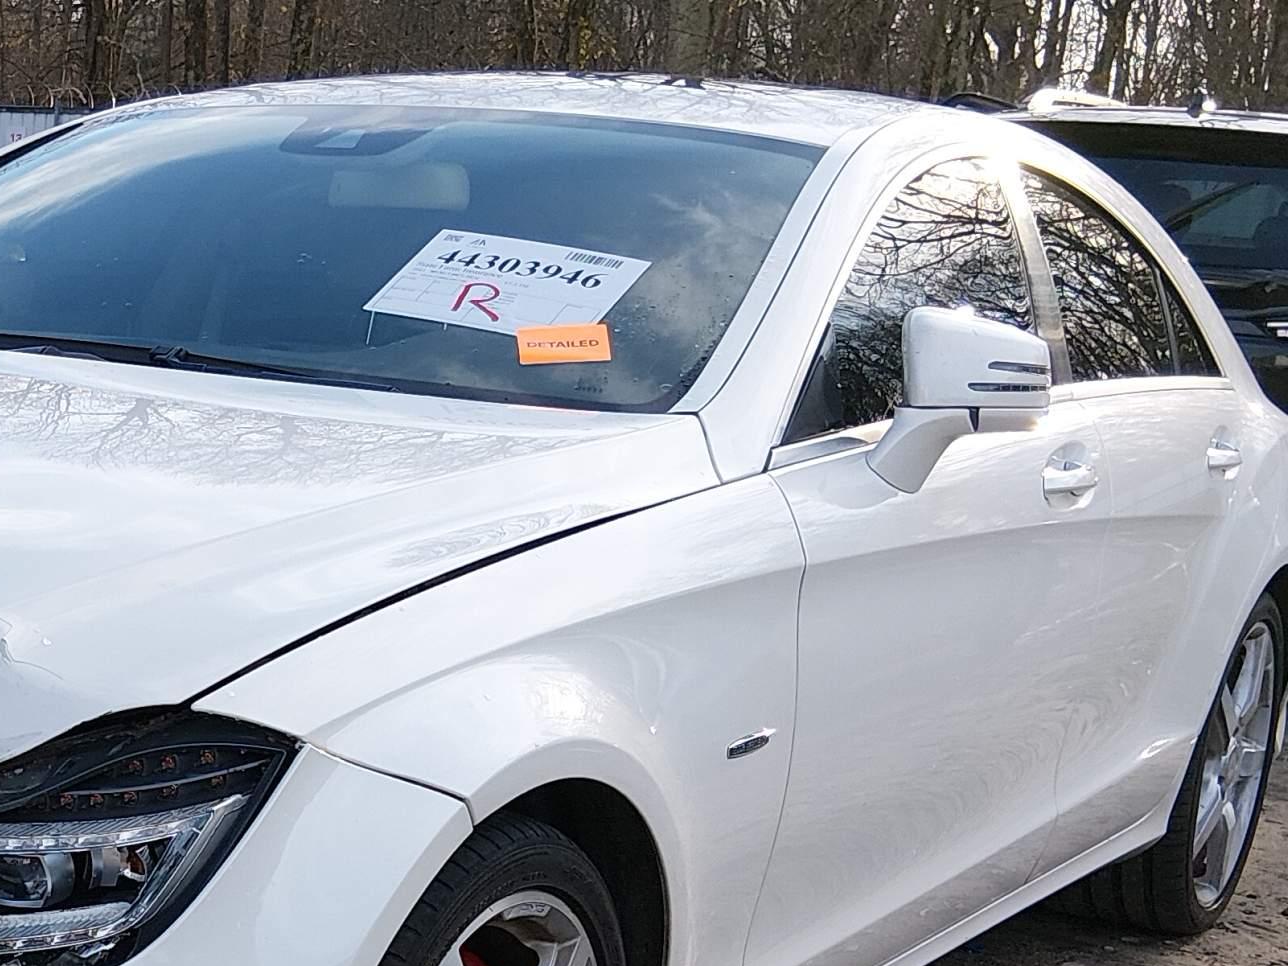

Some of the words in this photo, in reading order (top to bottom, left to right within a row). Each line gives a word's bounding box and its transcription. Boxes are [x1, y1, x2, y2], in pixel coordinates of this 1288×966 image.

[437, 249, 608, 289] 44303946
[451, 282, 500, 322] R
[527, 339, 600, 348] DETAILED
